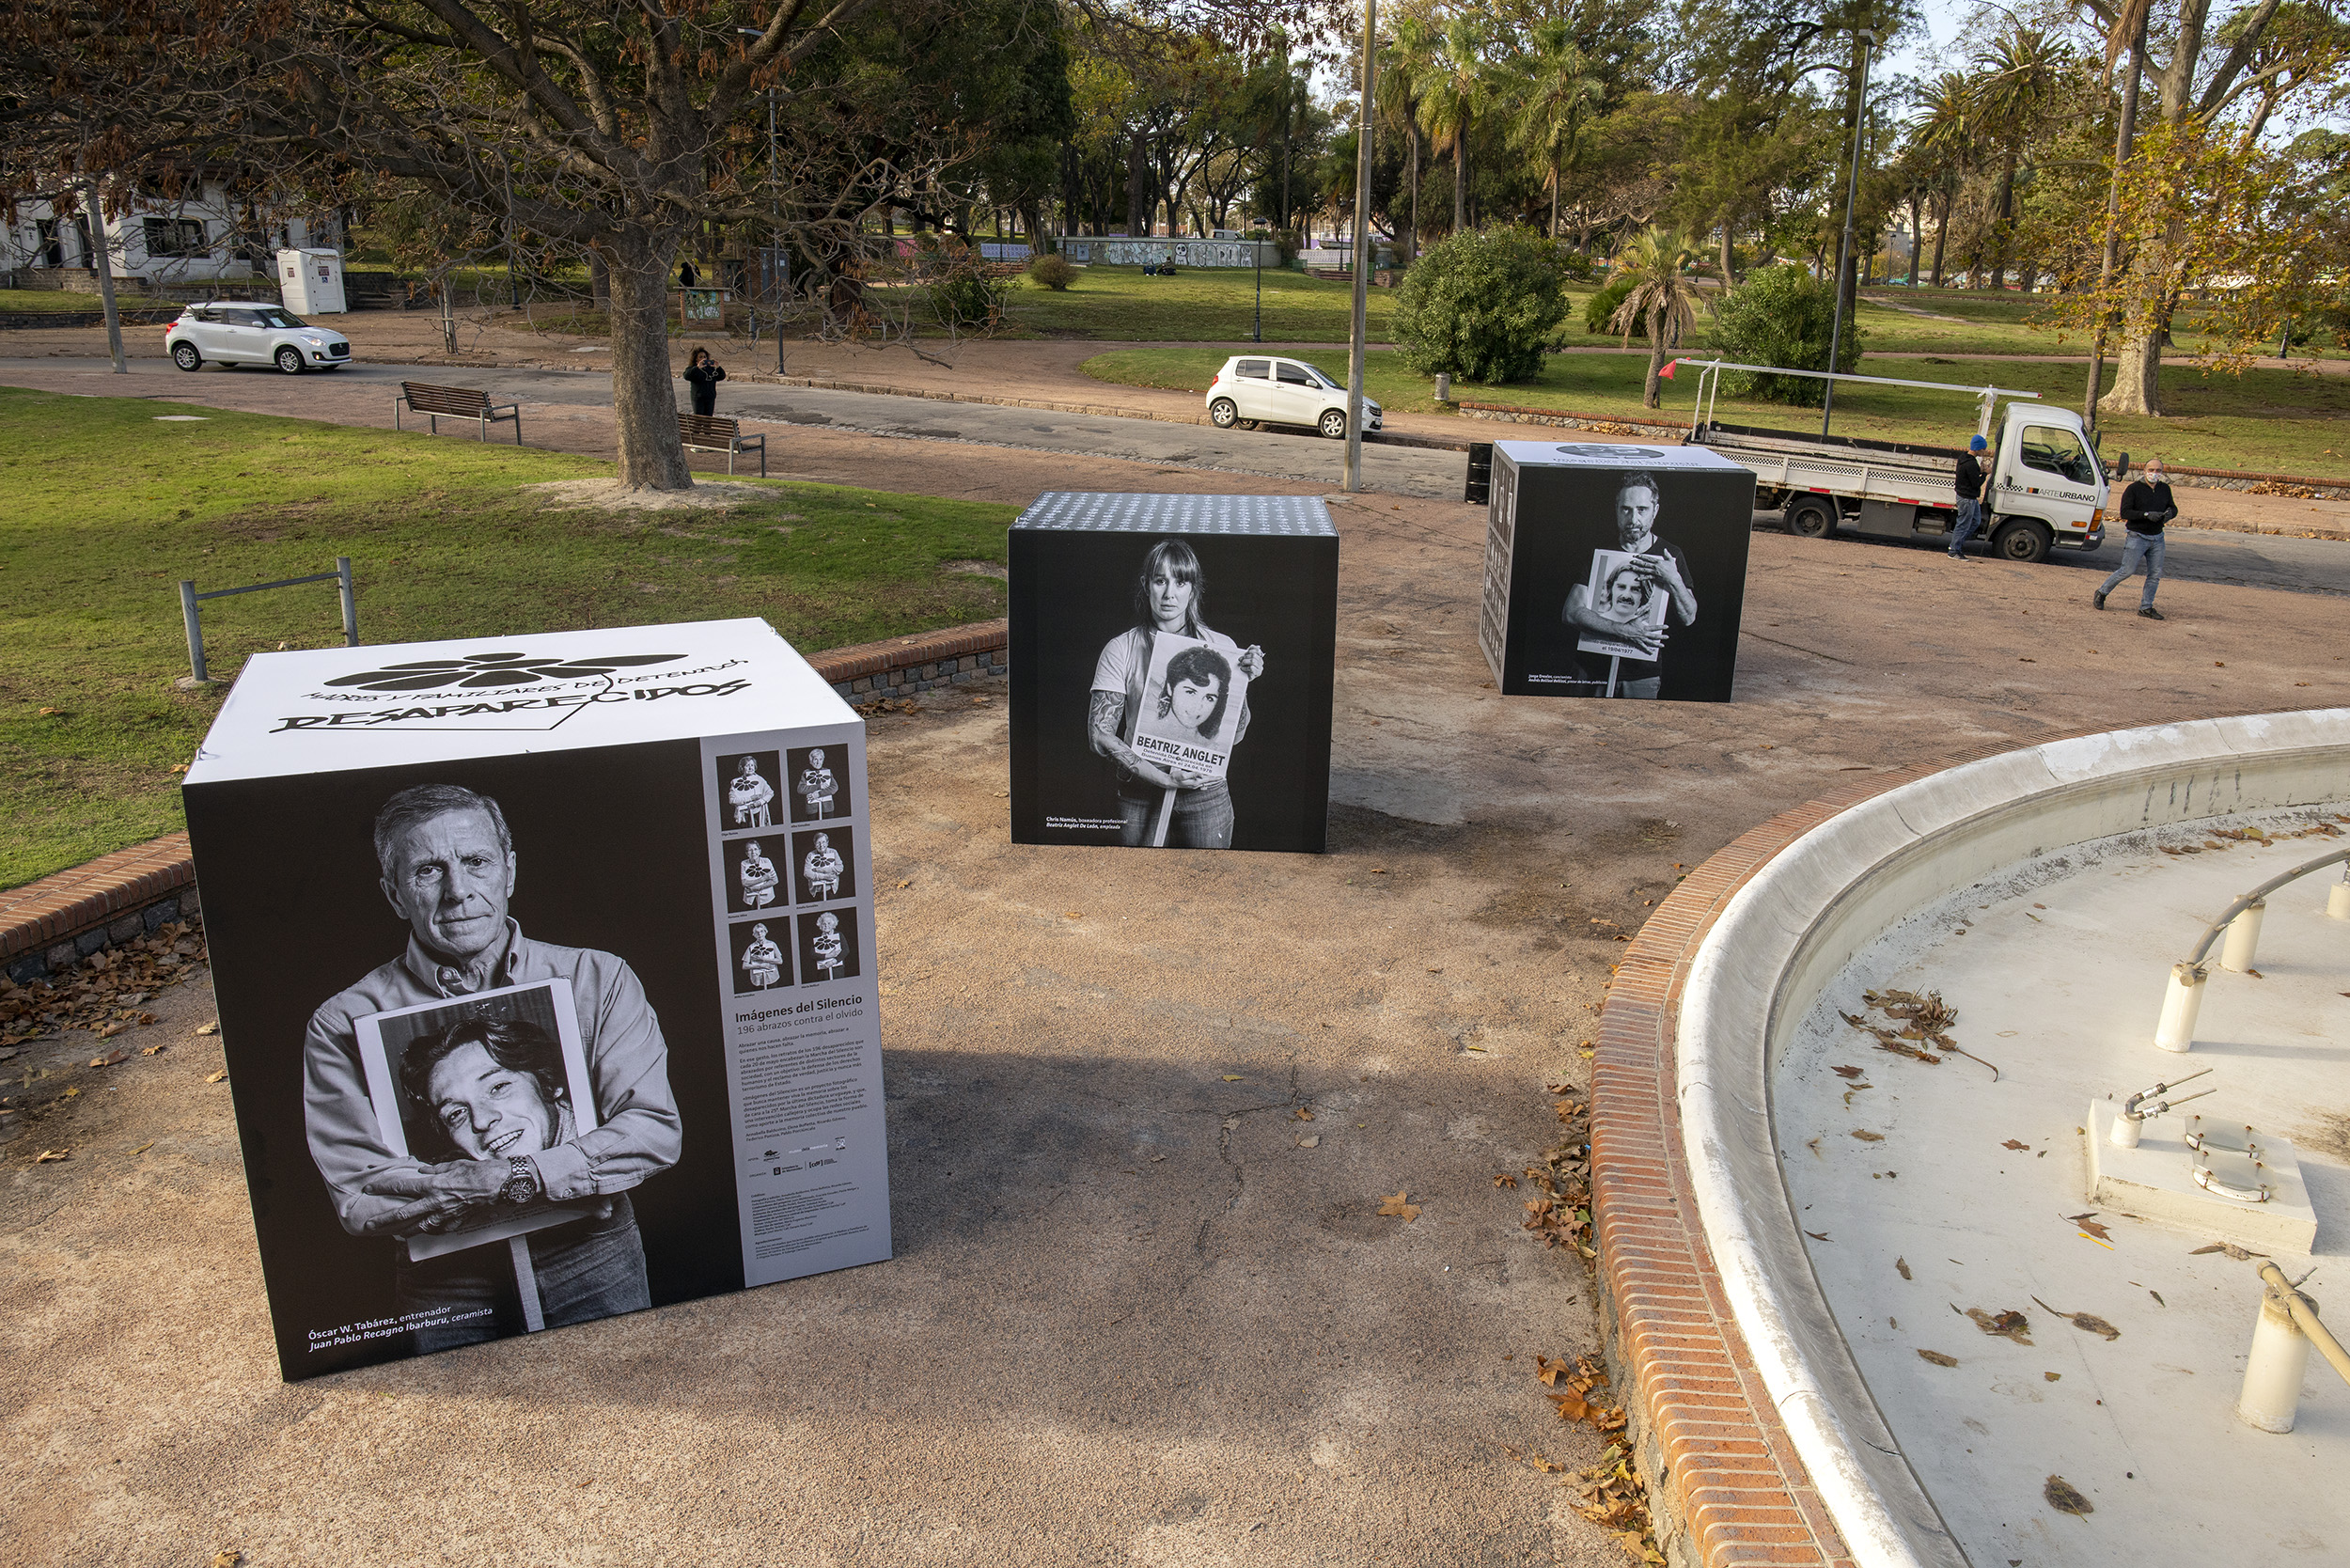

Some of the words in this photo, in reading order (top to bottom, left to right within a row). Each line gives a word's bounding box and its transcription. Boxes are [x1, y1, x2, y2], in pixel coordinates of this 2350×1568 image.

[2039, 489, 2095, 502] ARTEURBANO
[411, 683, 567, 701] FAMILIARES
[574, 680, 605, 689] DE
[618, 659, 749, 684] DETENIDOS
[268, 679, 752, 733] DESAPARECIDOS
[1136, 736, 1182, 755] BEATRIZ
[1183, 747, 1226, 766] ANGLET
[1141, 752, 1162, 761] Buenos
[1162, 757, 1177, 765] Aires
[735, 1007, 793, 1024] Imágenes
[795, 1000, 814, 1014] del
[816, 994, 863, 1011] Silencio
[737, 1024, 755, 1035] 196
[757, 1018, 792, 1032] abrazos
[793, 1013, 823, 1027] contra
[825, 1011, 834, 1021] el
[836, 1008, 863, 1020] olvido
[308, 1329, 337, 1341] Óscar
[339, 1324, 353, 1335] W.
[354, 1317, 398, 1331] Tabárez,
[400, 1306, 451, 1323] entrenador
[308, 1340, 332, 1353] Juan
[334, 1333, 361, 1345] Pablo
[364, 1325, 404, 1340] Recagno
[406, 1317, 449, 1331] Ibarburu,
[451, 1307, 493, 1323] ceramista
